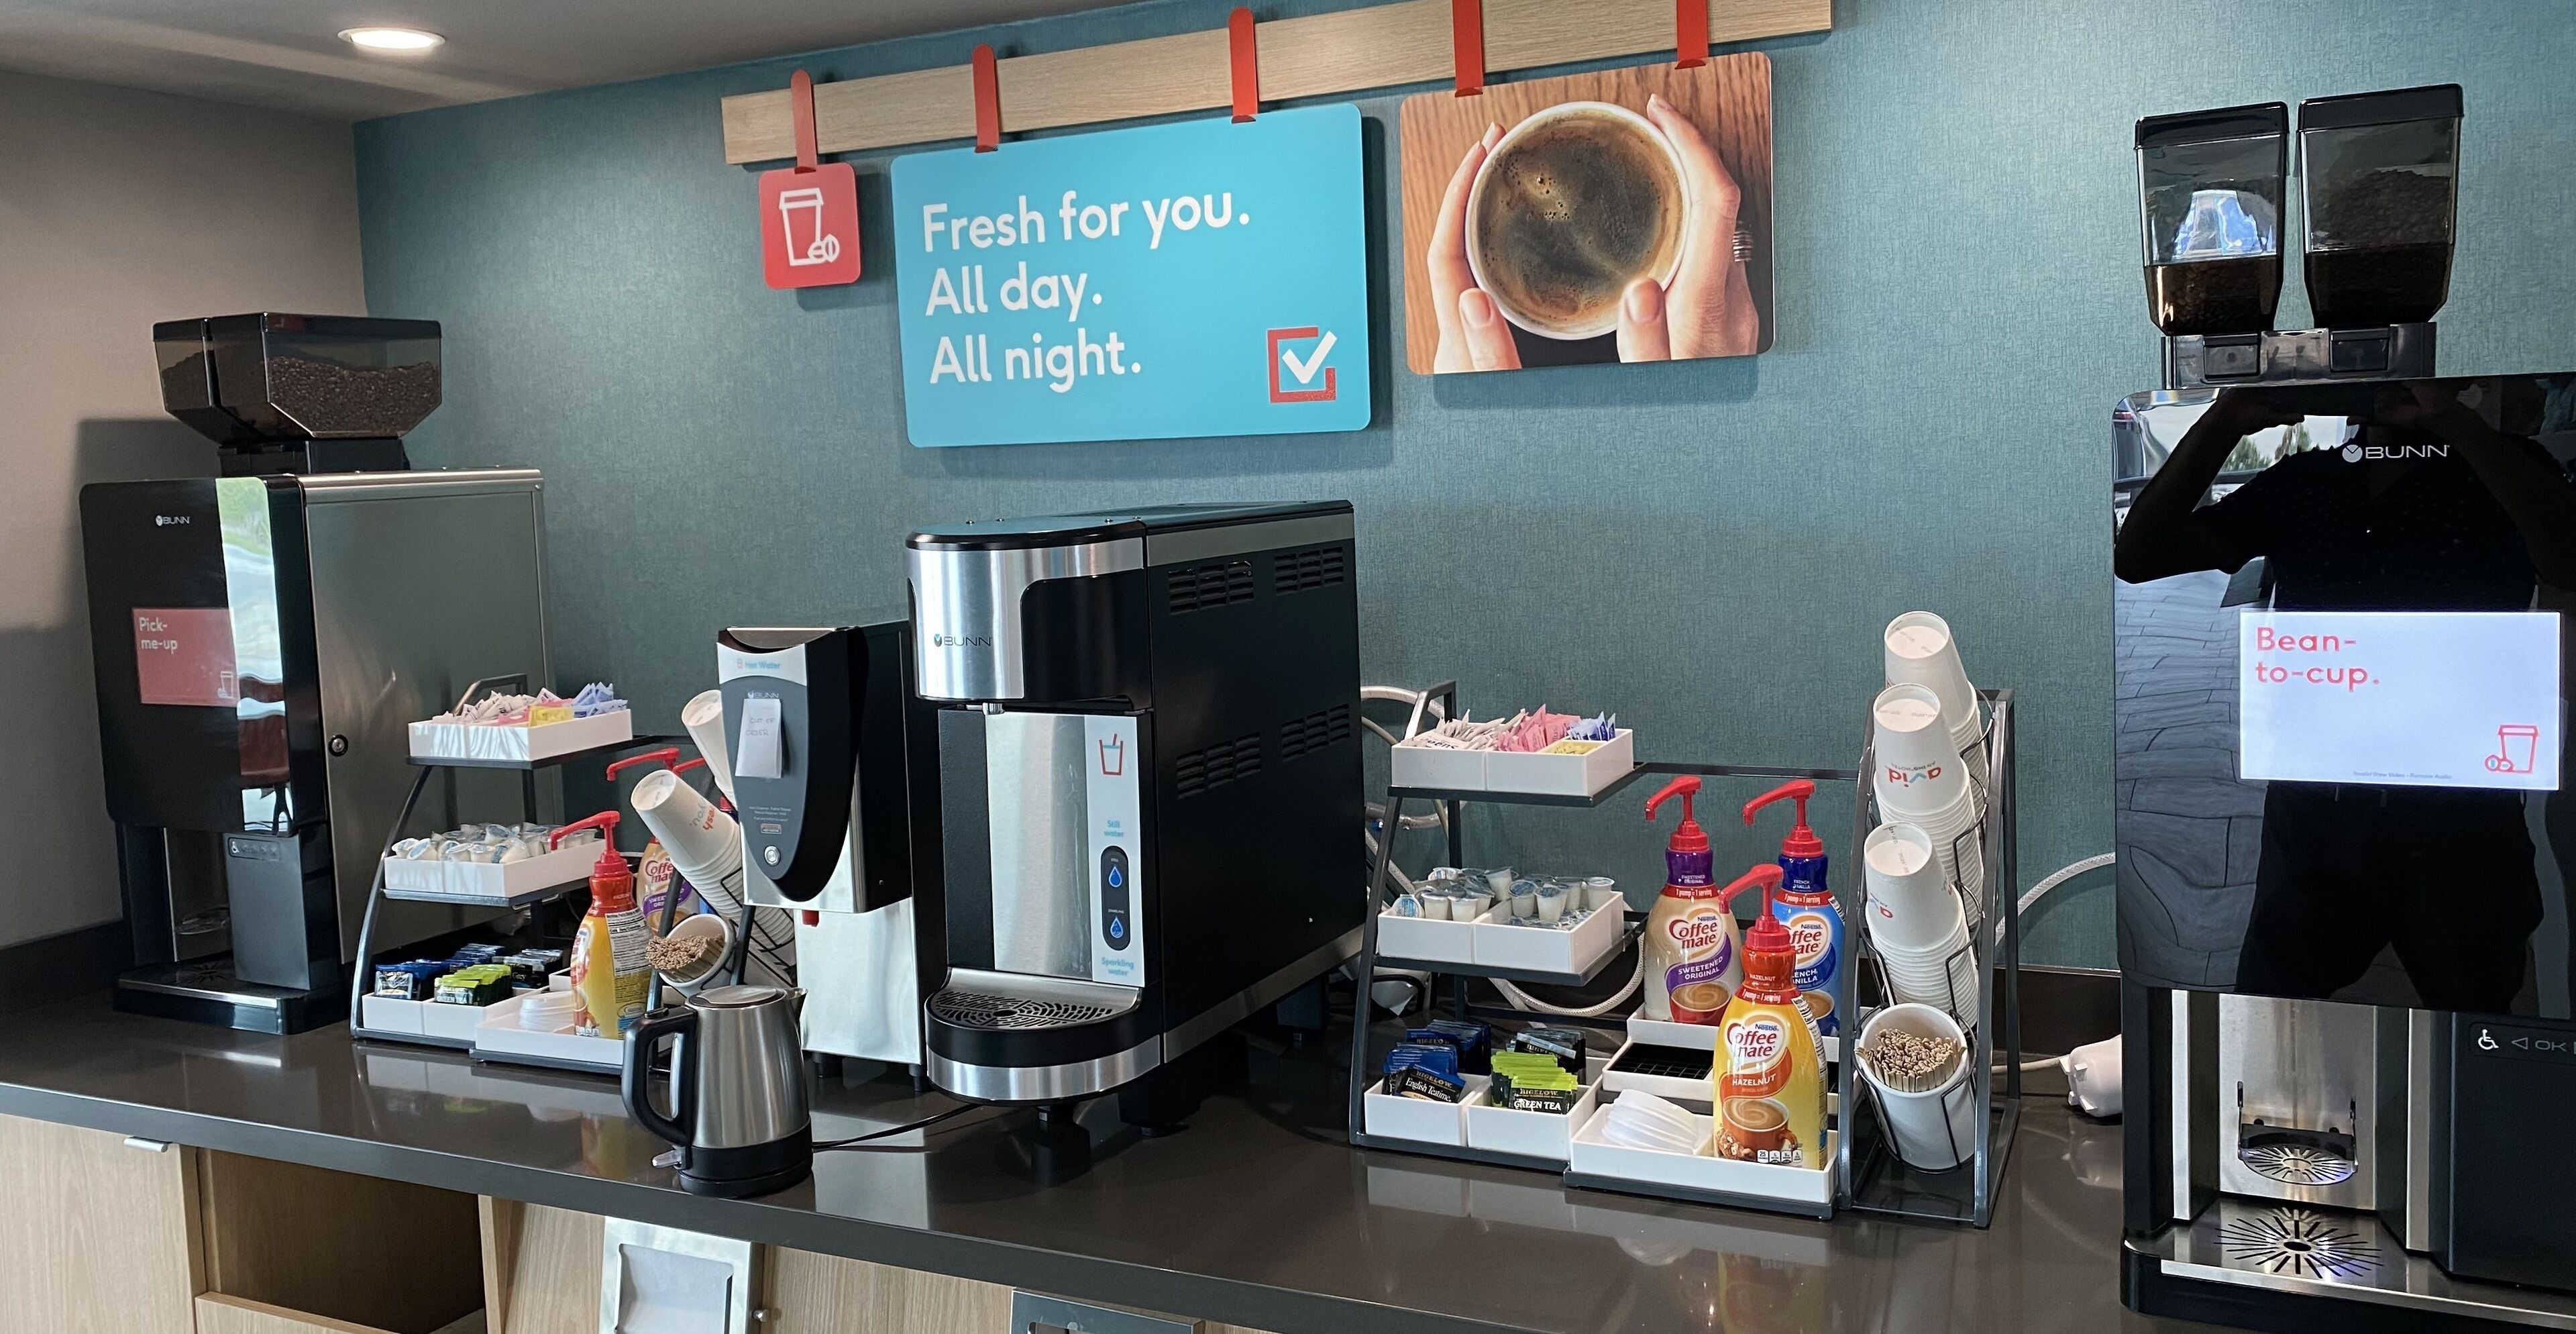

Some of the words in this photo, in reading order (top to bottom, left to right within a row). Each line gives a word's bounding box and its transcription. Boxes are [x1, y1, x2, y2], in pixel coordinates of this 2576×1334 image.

[923, 195, 1046, 252] Fresh
[1059, 190, 1130, 241] for
[1142, 192, 1250, 250] you.
[925, 264, 989, 316] All
[1000, 261, 1103, 323] day.
[930, 334, 993, 384] All
[1005, 327, 1142, 394] night.
[2365, 444, 2450, 459] BUNN
[163, 516, 191, 524] BUNN
[139, 617, 168, 631] Pick-
[141, 639, 178, 654] me-up
[944, 636, 991, 647] BUNN
[2256, 627, 2357, 652] Bean-
[759, 660, 781, 669] Water
[2255, 661, 2380, 692] to-cup.
[1888, 767, 1941, 788] avid
[1107, 820, 1120, 828] Still
[645, 860, 674, 876] Coffe
[1669, 919, 1717, 940] Coffee
[1790, 929, 1823, 944] ffee
[1681, 933, 1717, 949] mate
[1793, 942, 1819, 954] ate
[1678, 956, 1723, 975] SWEETENED
[1684, 967, 1720, 980] ORIGINAL
[1749, 973, 1776, 982] HAZELNUT
[1792, 968, 1818, 979] ENCH
[1727, 1022, 1777, 1046] Coffee
[2536, 1040, 2566, 1052] OK
[1405, 1077, 1428, 1093] English
[1415, 1072, 1453, 1089] BIGELOW
[1732, 1074, 1776, 1086] HAZELNUT
[1519, 1088, 1558, 1096] BIGELOW
[1513, 1098, 1542, 1110] GREEN
[1544, 1100, 1562, 1111] TEA
